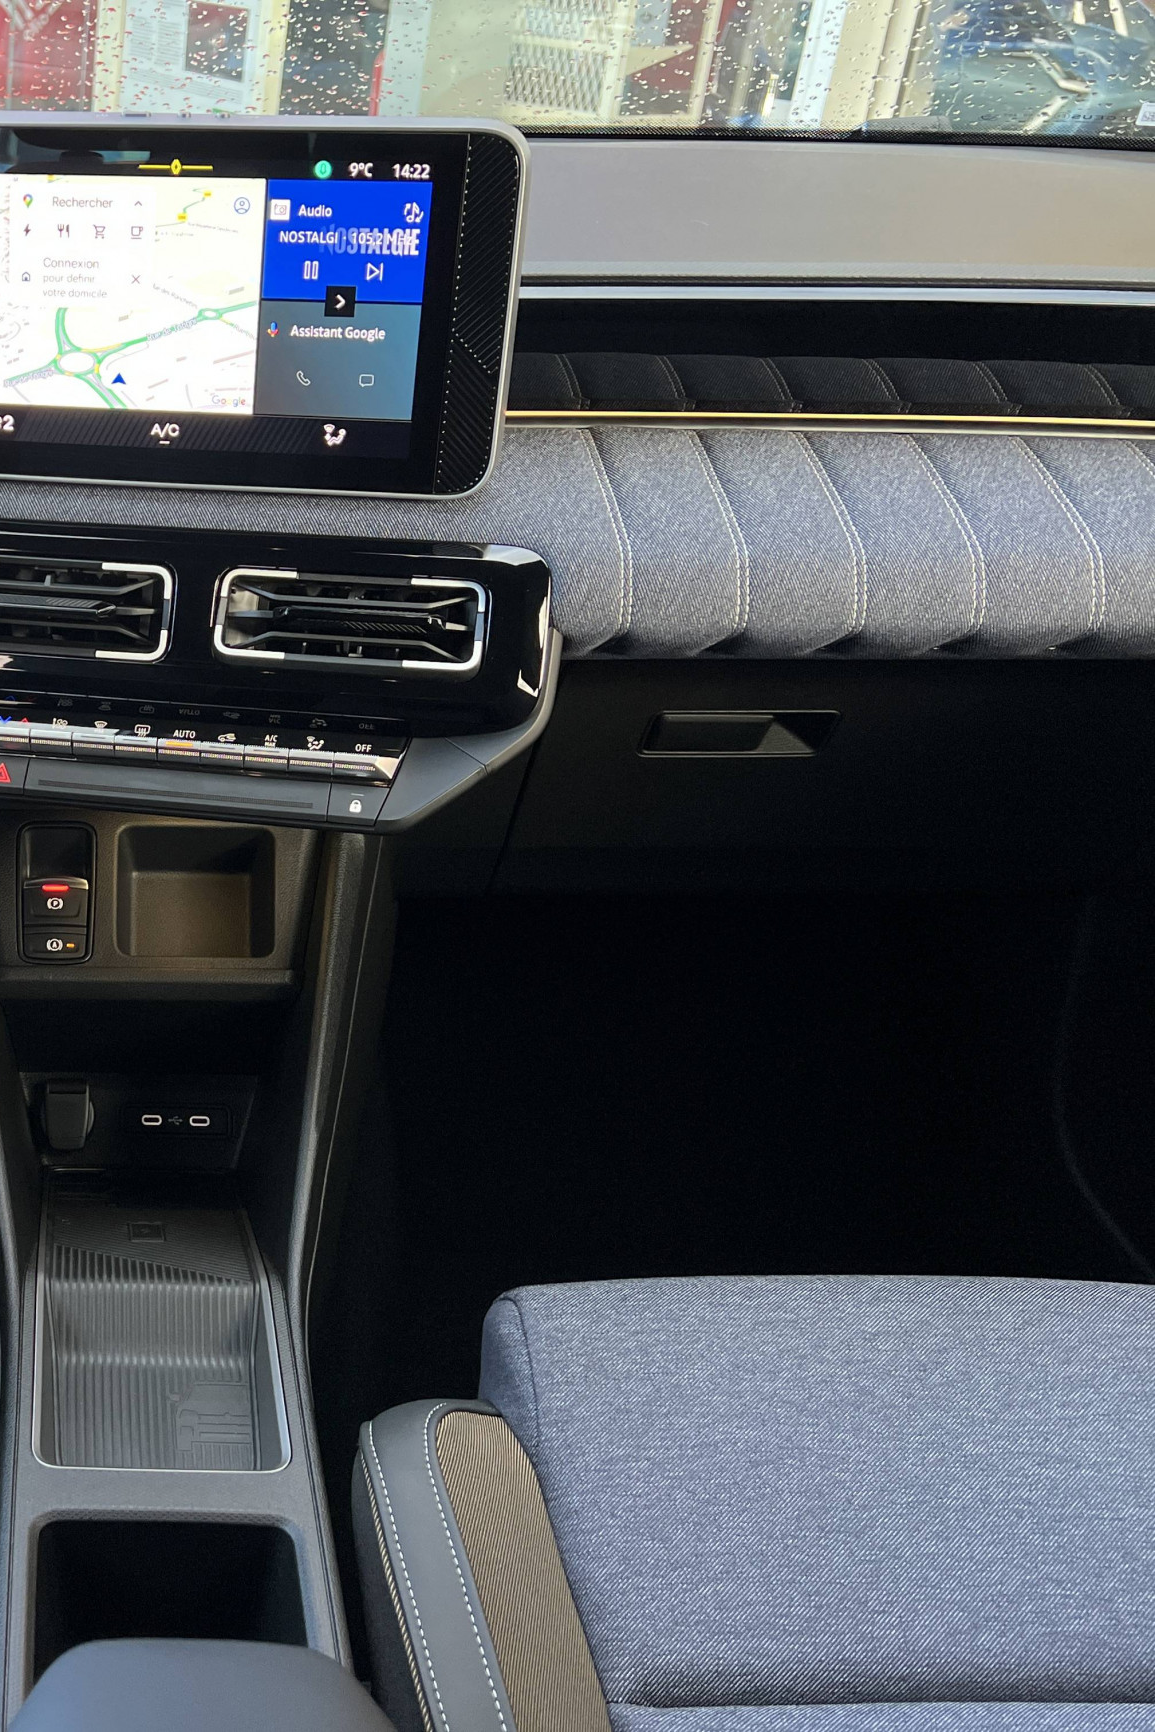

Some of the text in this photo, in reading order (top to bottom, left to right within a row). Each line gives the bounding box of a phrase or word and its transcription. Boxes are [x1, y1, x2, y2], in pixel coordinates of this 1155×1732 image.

[393, 163, 431, 179] 14:22
[52, 196, 113, 208] Rechercher
[298, 204, 333, 217] Audio
[43, 257, 100, 269] Connexion
[42, 275, 64, 284] pour
[42, 289, 108, 299] votre domicile
[290, 325, 386, 342] Assistant Google
[211, 395, 247, 408] Google
[150, 422, 180, 438] A/C
[172, 729, 196, 739] AUTO
[264, 734, 278, 742] A/C
[354, 743, 372, 752] OFF
